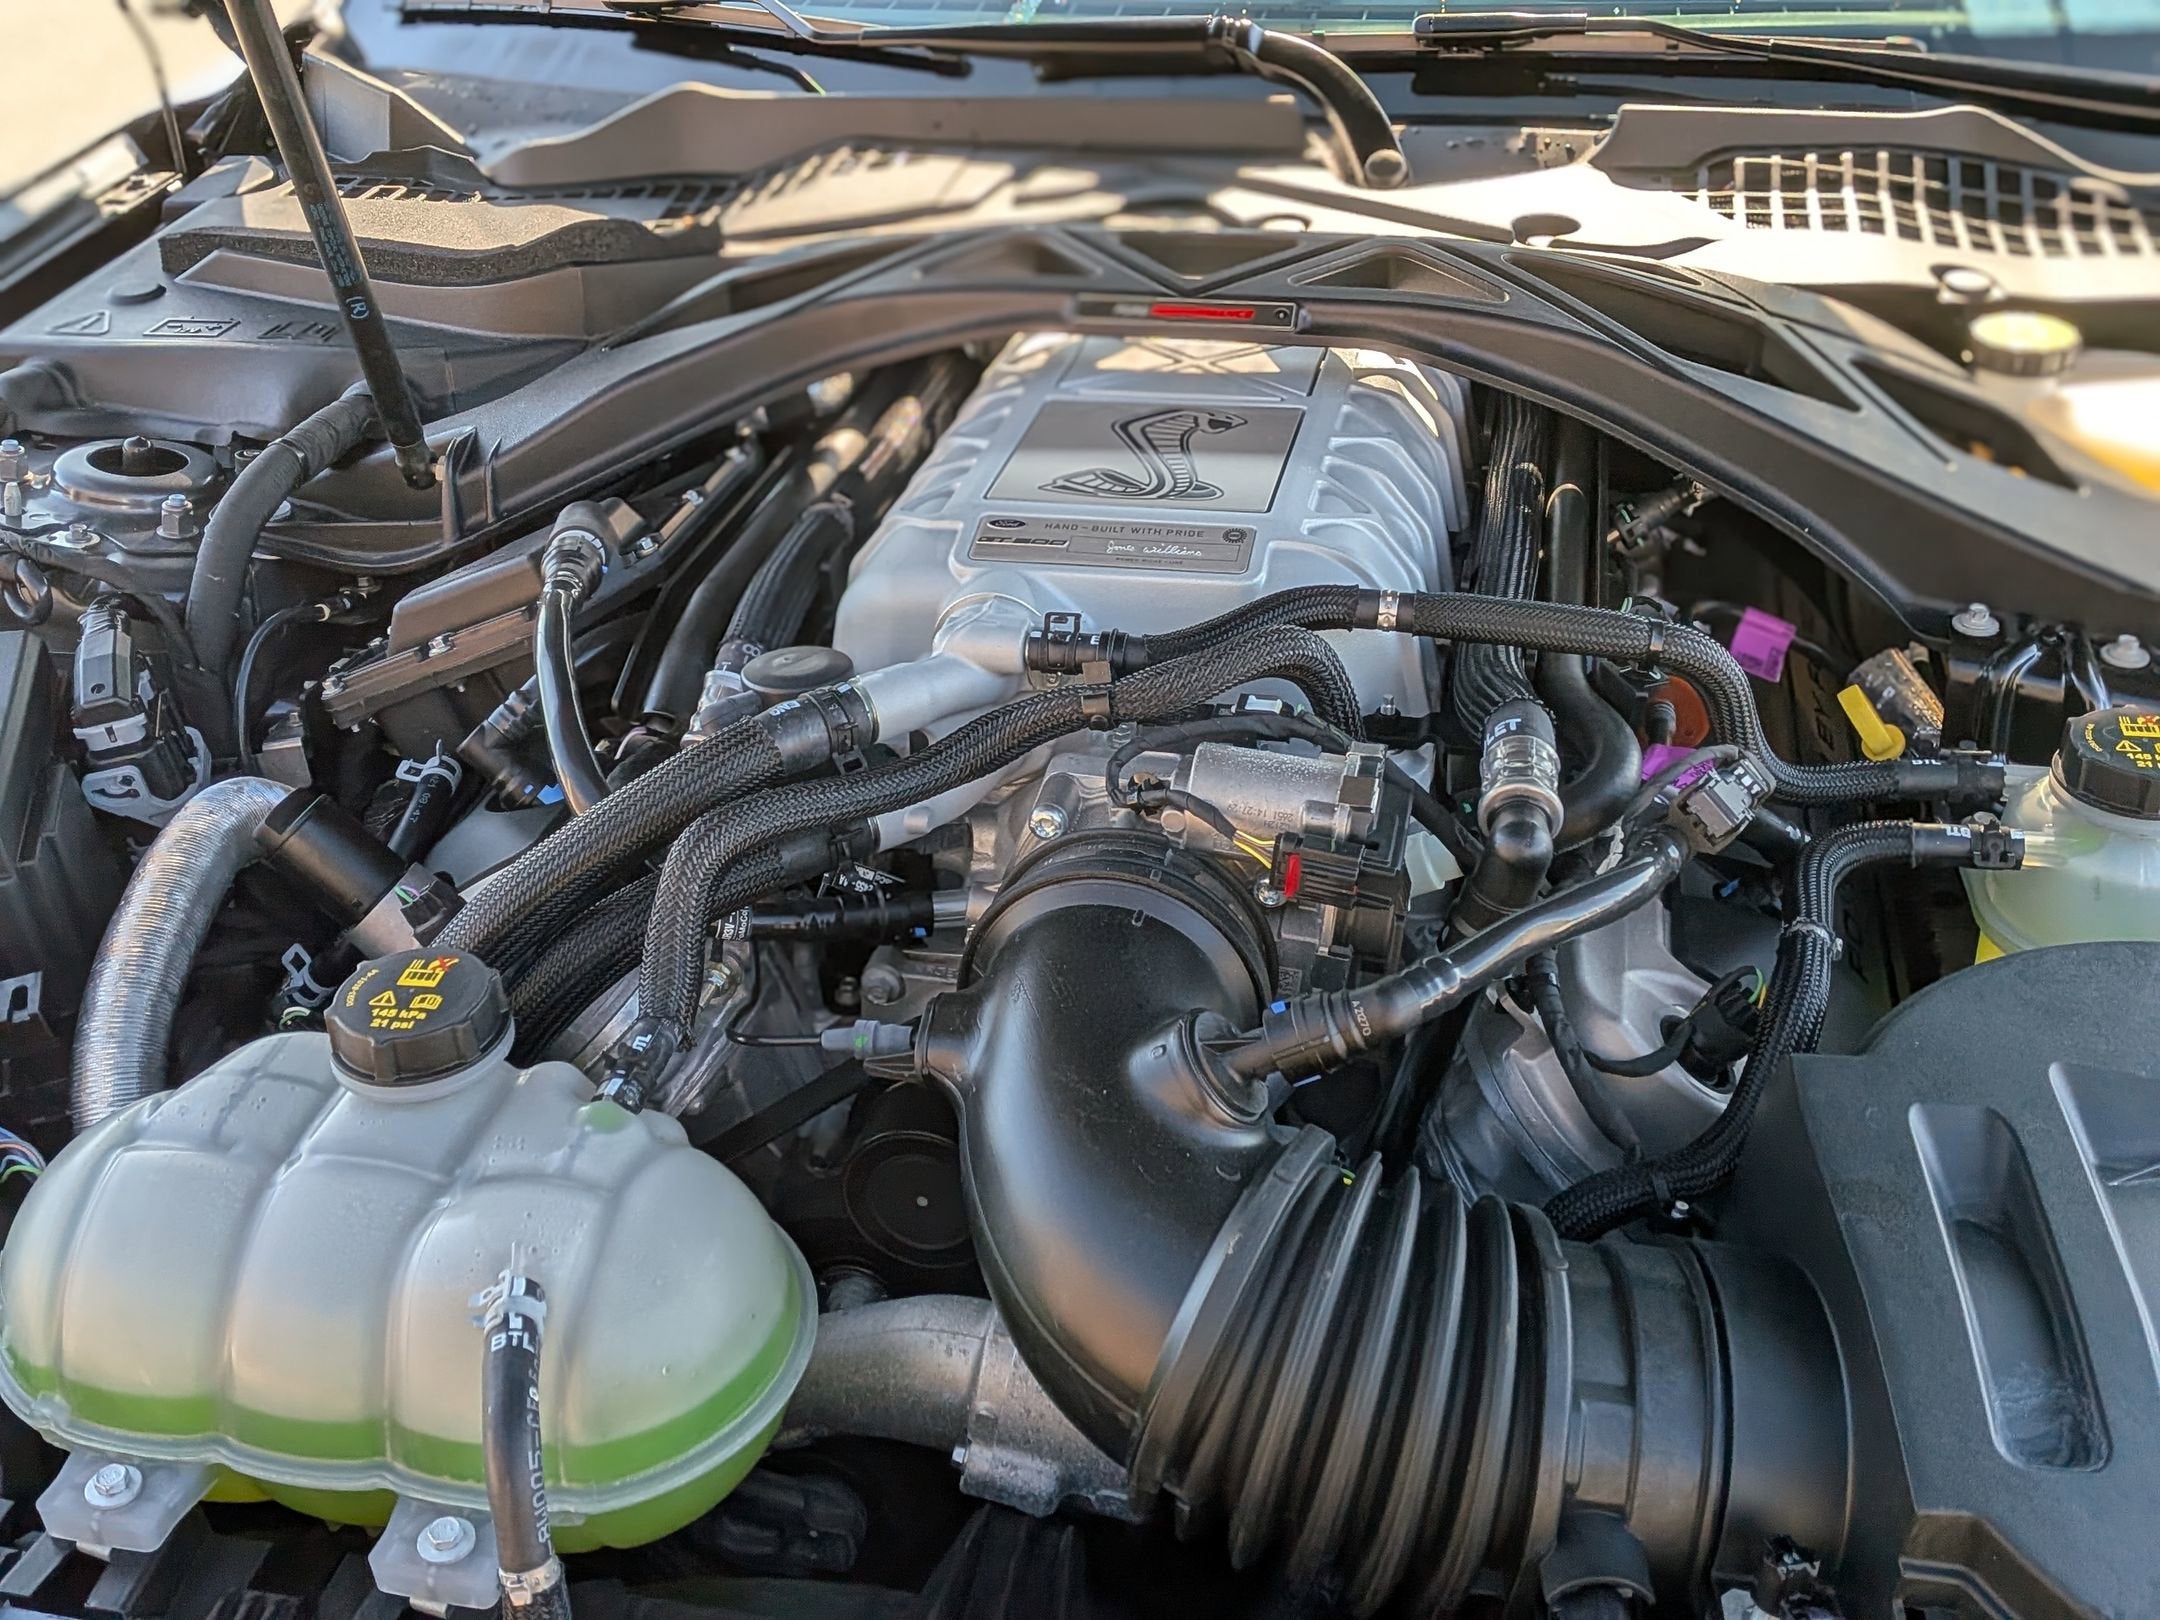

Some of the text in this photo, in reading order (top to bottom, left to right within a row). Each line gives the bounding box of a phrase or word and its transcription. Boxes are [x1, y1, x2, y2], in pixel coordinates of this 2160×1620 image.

[1131, 527, 1162, 535] WITH
[1166, 528, 1205, 537] PRIDE
[371, 1008, 427, 1020] 145 kPa
[369, 1019, 415, 1030] 21 psi
[490, 1330, 536, 1353] BTL
